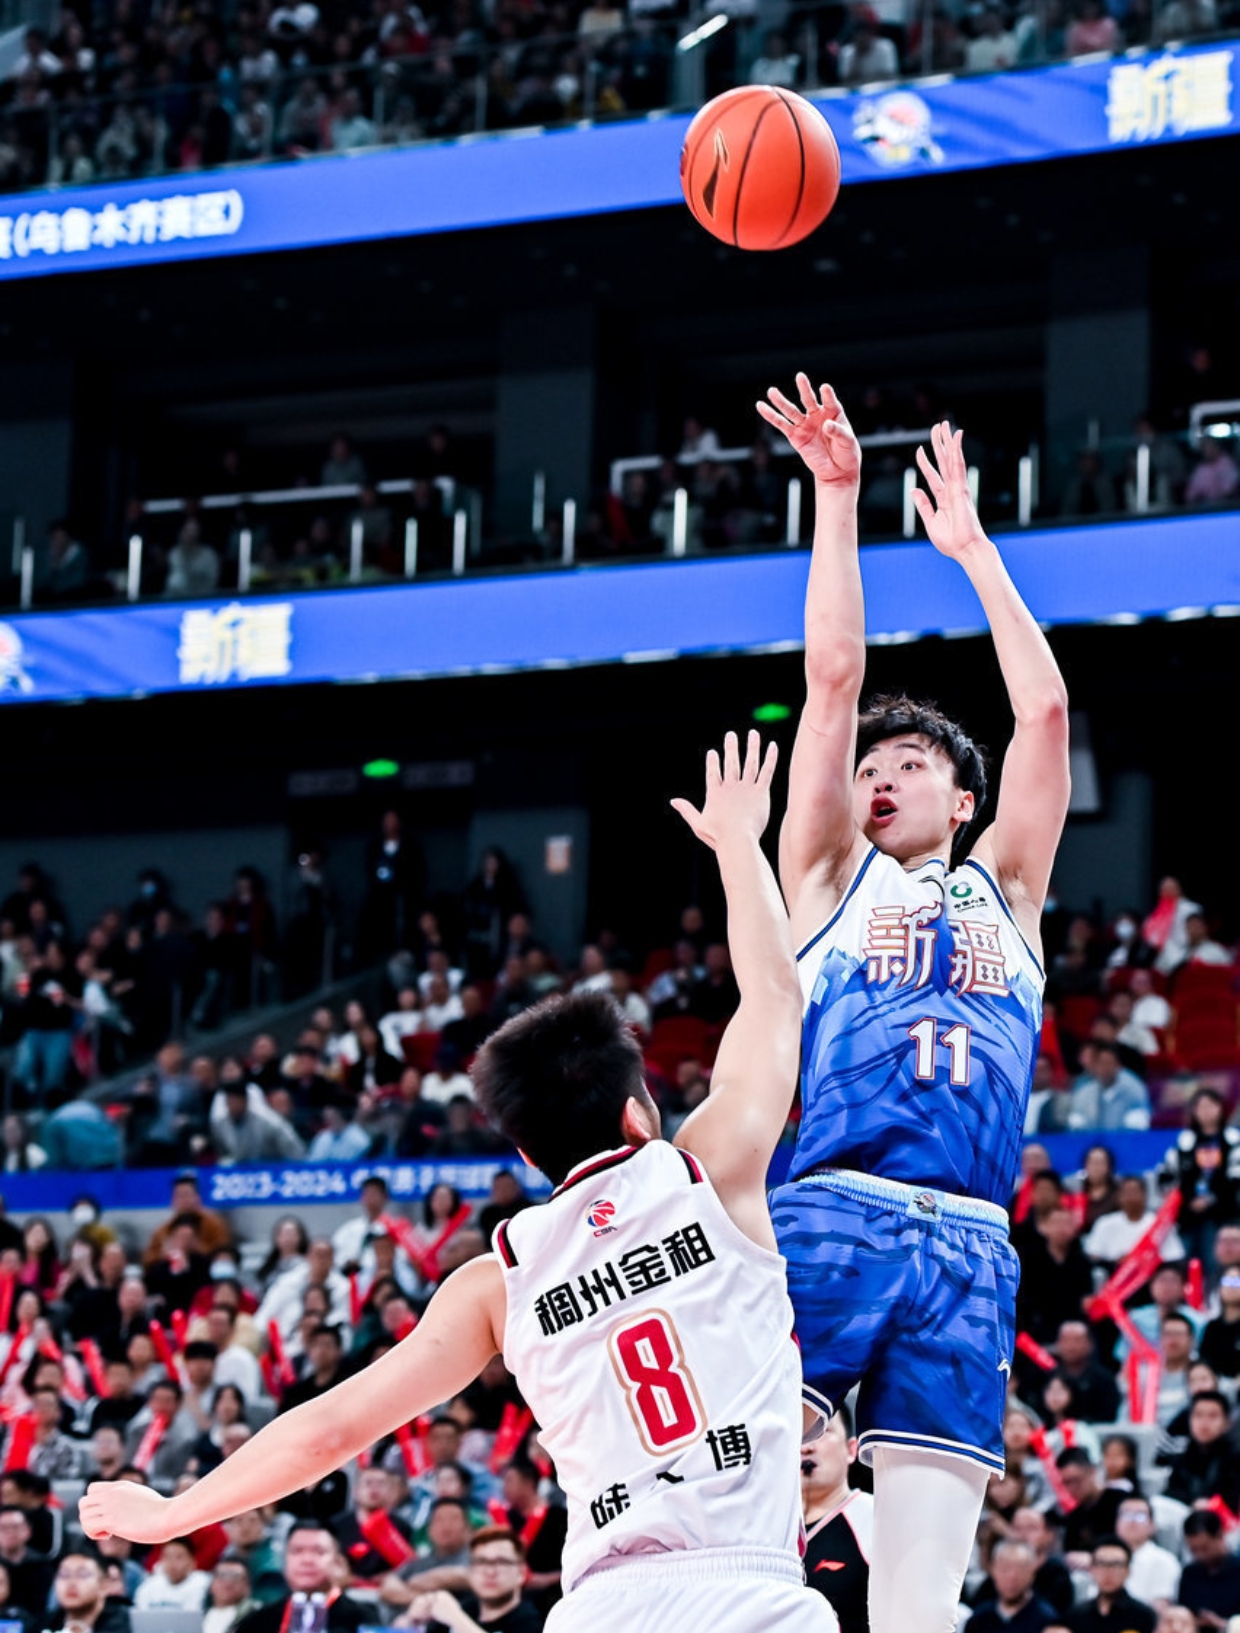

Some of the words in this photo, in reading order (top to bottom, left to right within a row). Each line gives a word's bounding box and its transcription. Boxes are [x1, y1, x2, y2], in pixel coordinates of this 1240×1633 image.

[1104, 50, 1233, 142] 新疆
[177, 602, 293, 684] 新疆
[862, 900, 1010, 998] 新疆
[907, 1016, 971, 1086] 11
[534, 1221, 716, 1336] 稠州金租
[607, 1308, 708, 1457] 8
[590, 1423, 752, 1530] 味博
